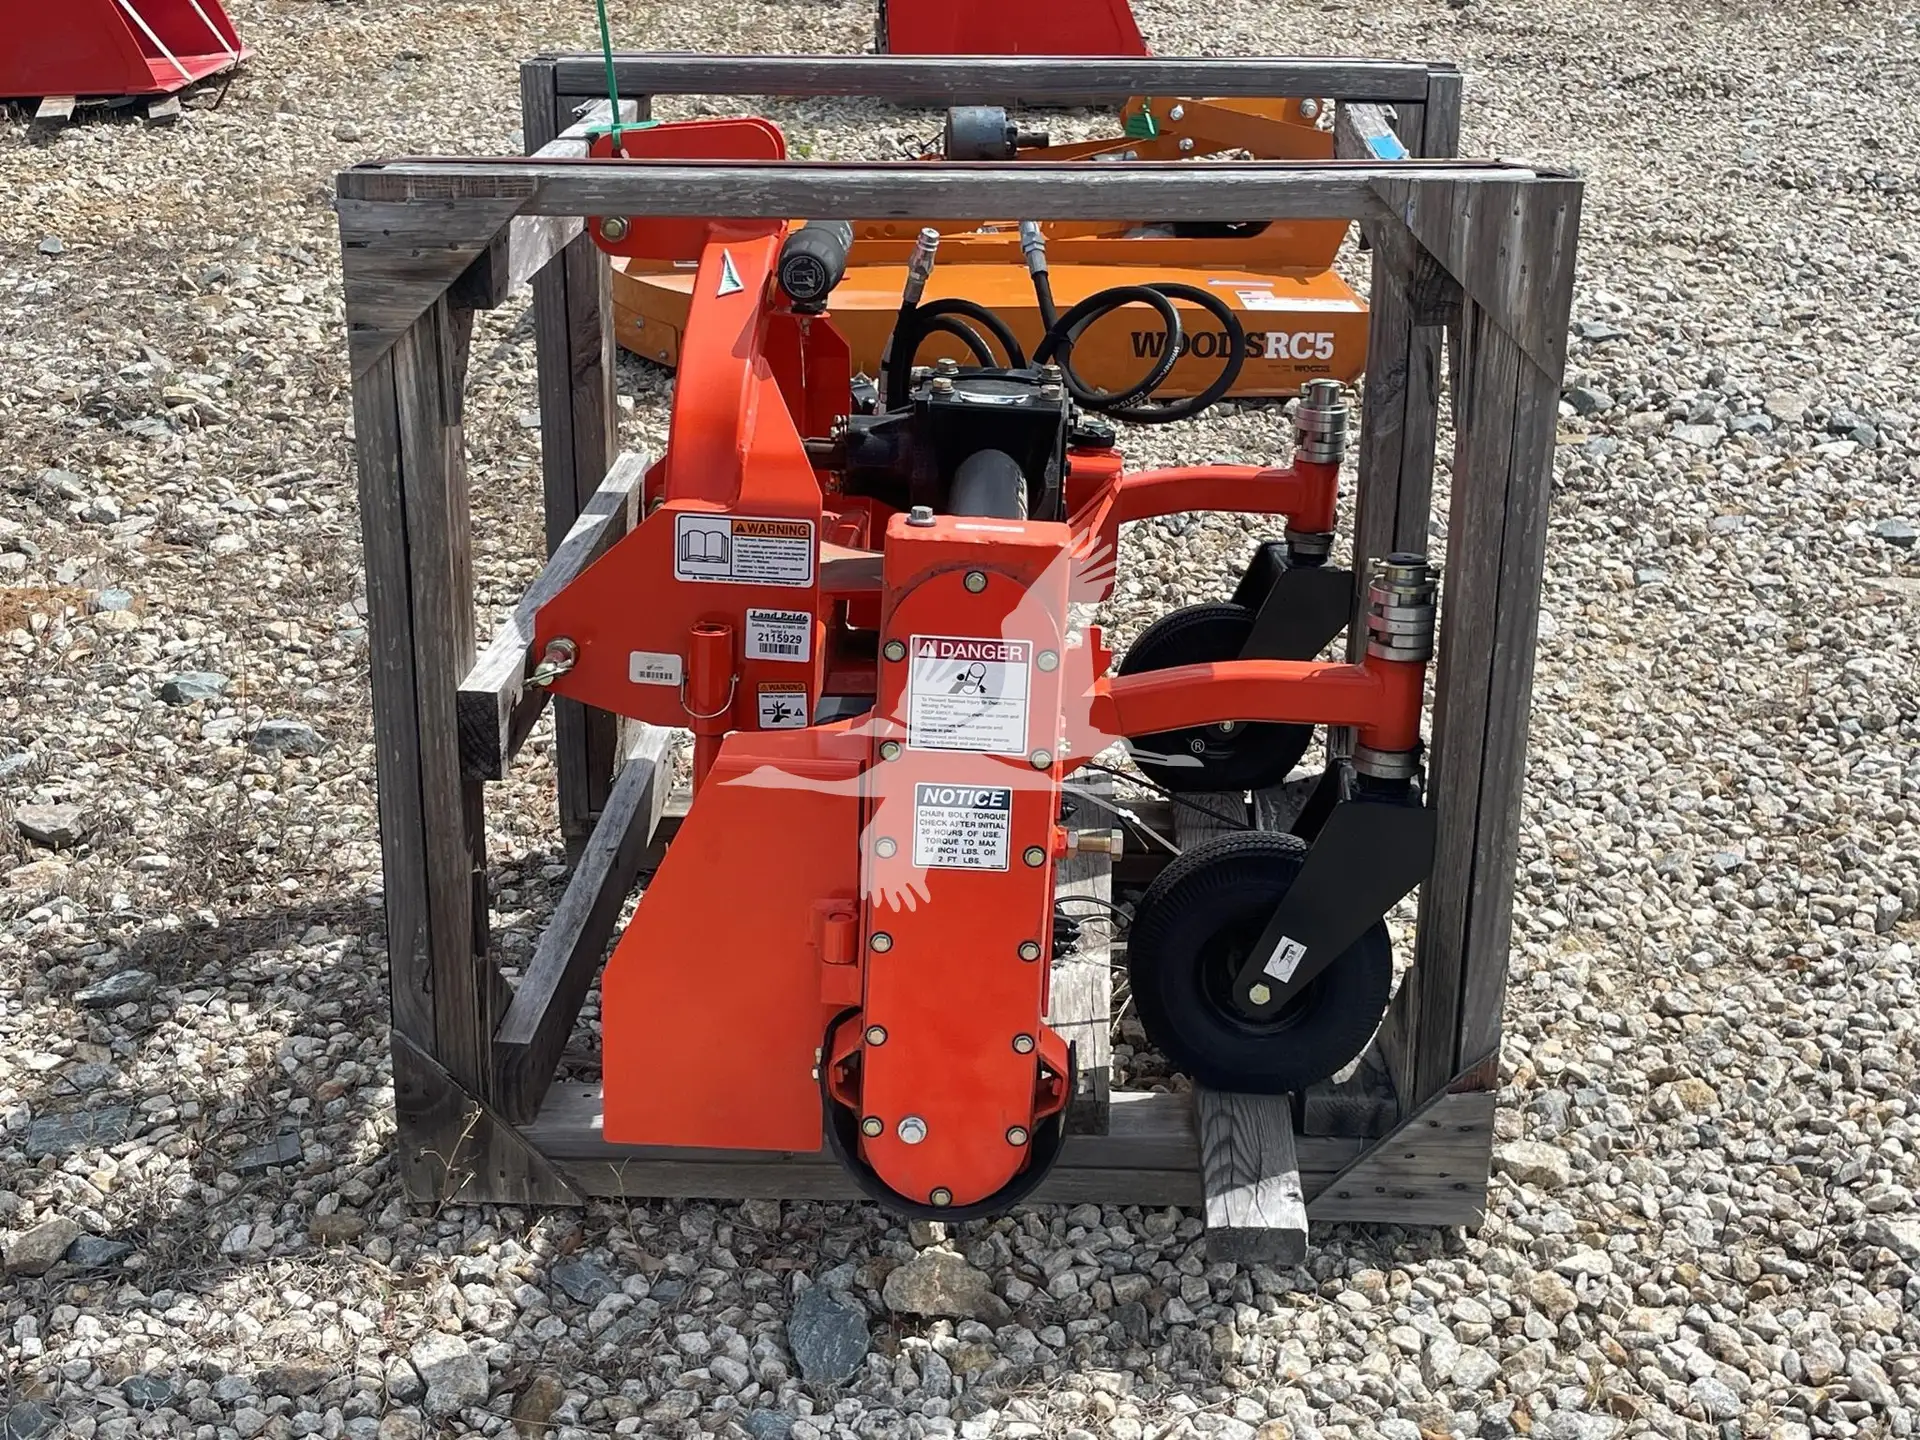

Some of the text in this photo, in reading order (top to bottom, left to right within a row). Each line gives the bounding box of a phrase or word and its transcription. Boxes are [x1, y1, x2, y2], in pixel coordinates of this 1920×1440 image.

[748, 523, 807, 536] WARNING
[750, 610, 808, 622] Land Pride
[758, 632, 802, 644] 2115929
[941, 642, 1022, 660] DANGER
[923, 788, 1004, 806] NOTICE
